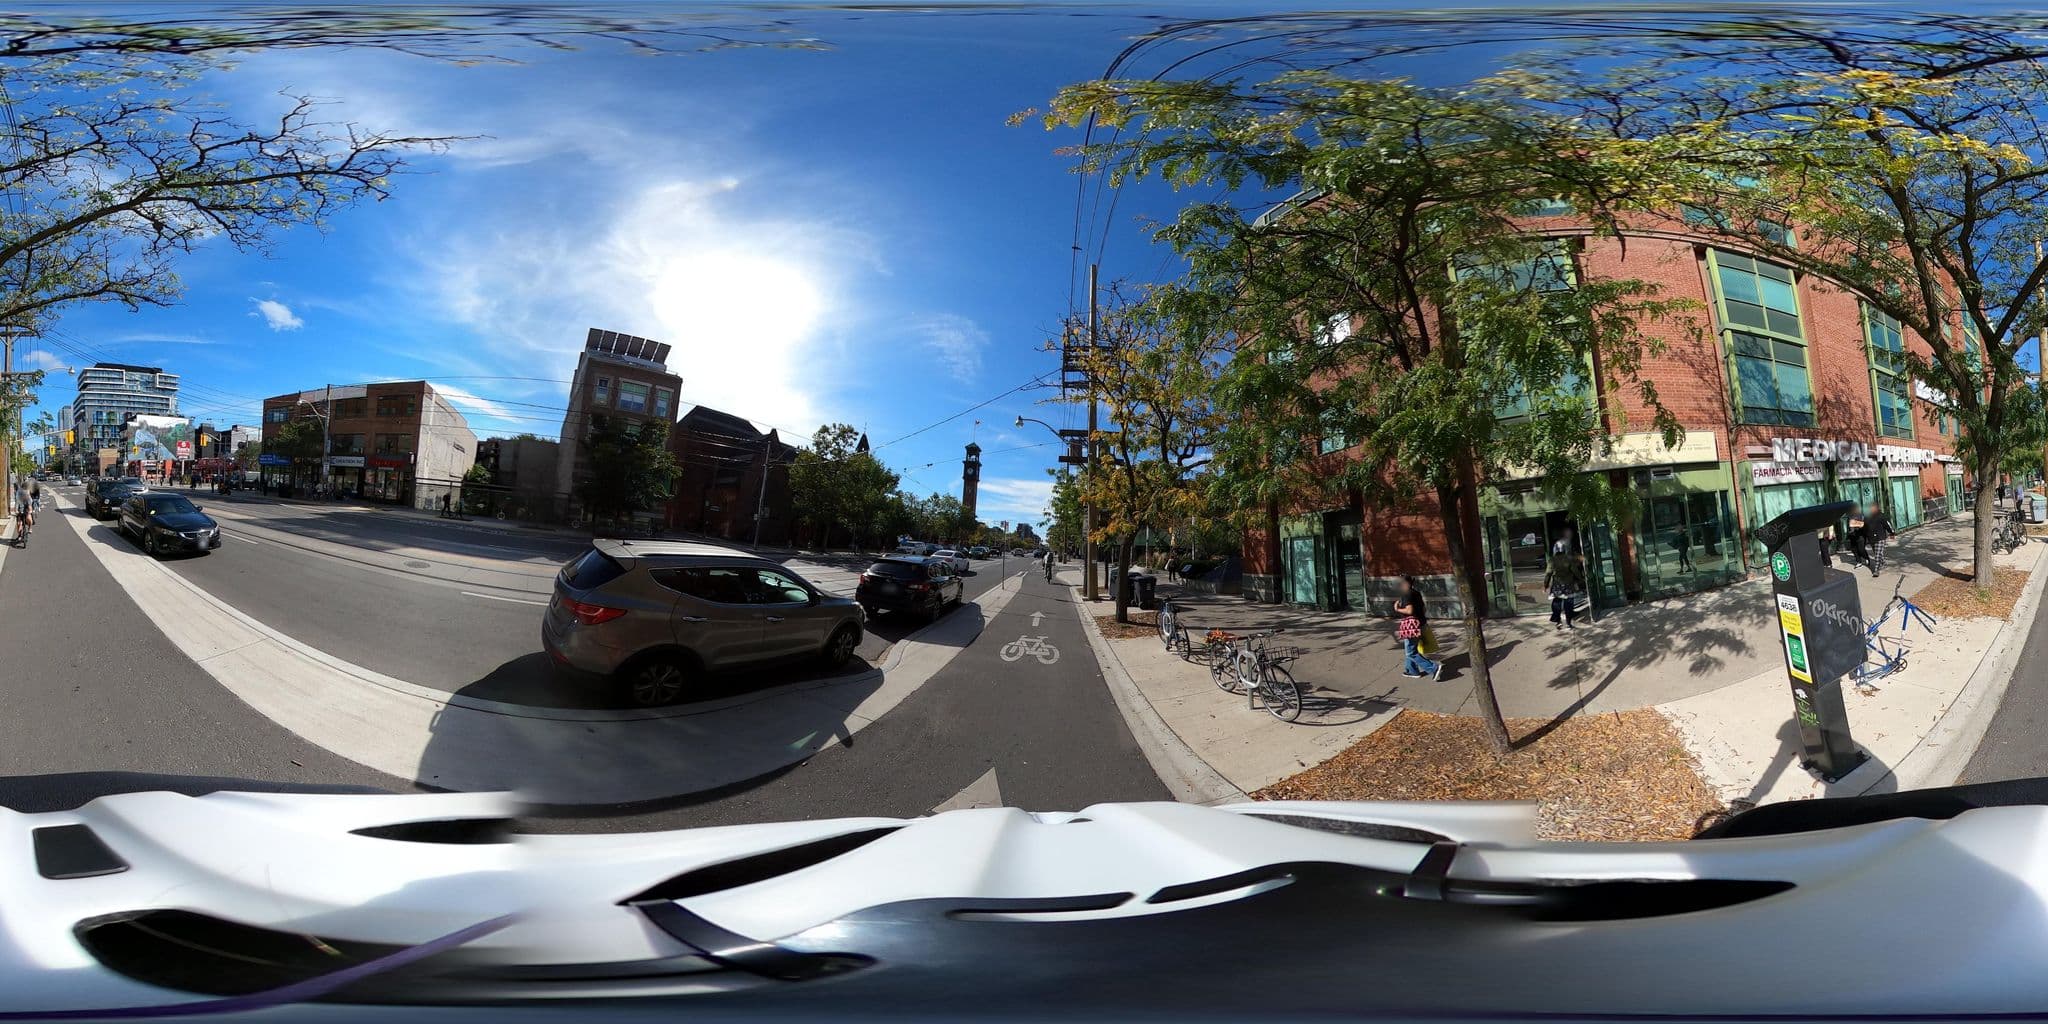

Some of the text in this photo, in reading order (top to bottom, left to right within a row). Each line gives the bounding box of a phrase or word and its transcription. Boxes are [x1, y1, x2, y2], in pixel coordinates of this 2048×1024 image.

[1771, 437, 1935, 464] MEDICAL PHARMACY
[1753, 466, 1822, 478] FARMACIA RECEITA
